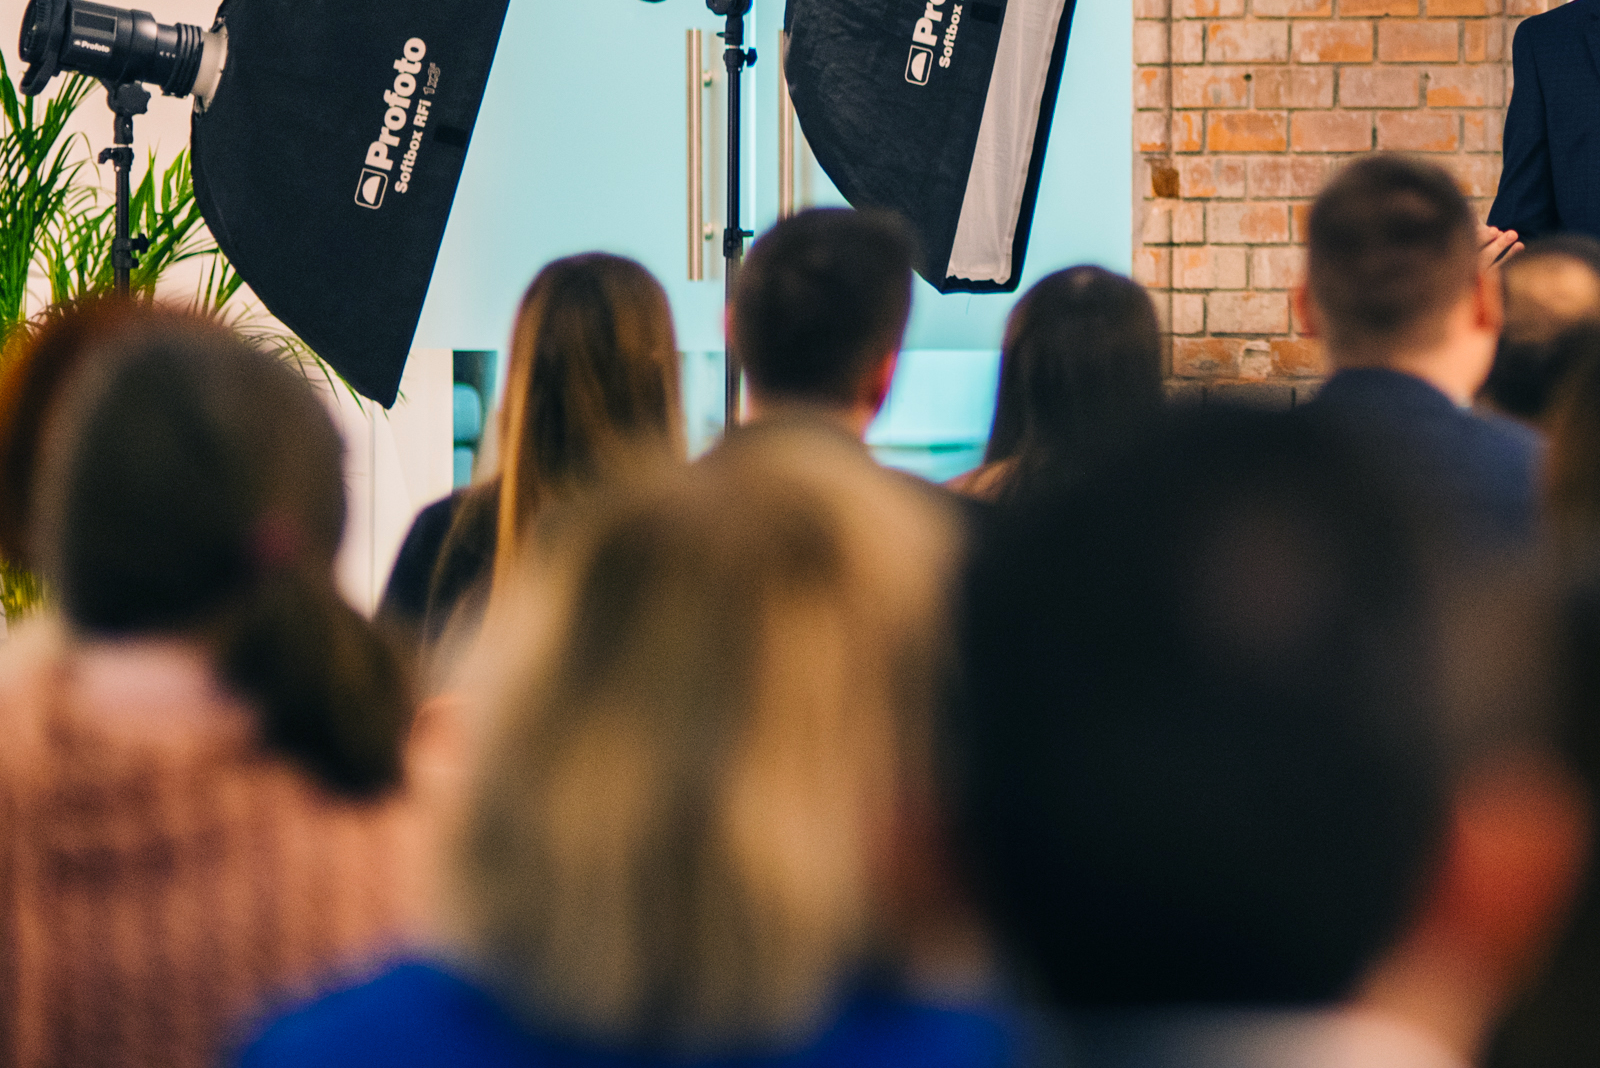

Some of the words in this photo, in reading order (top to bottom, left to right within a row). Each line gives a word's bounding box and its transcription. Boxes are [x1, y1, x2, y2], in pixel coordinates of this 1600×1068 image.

[81, 40, 111, 53] Profoto
[938, 3, 963, 68] Softbox
[364, 37, 427, 171] Profoto
[394, 129, 424, 194] Softbox
[412, 98, 432, 127] RFi
